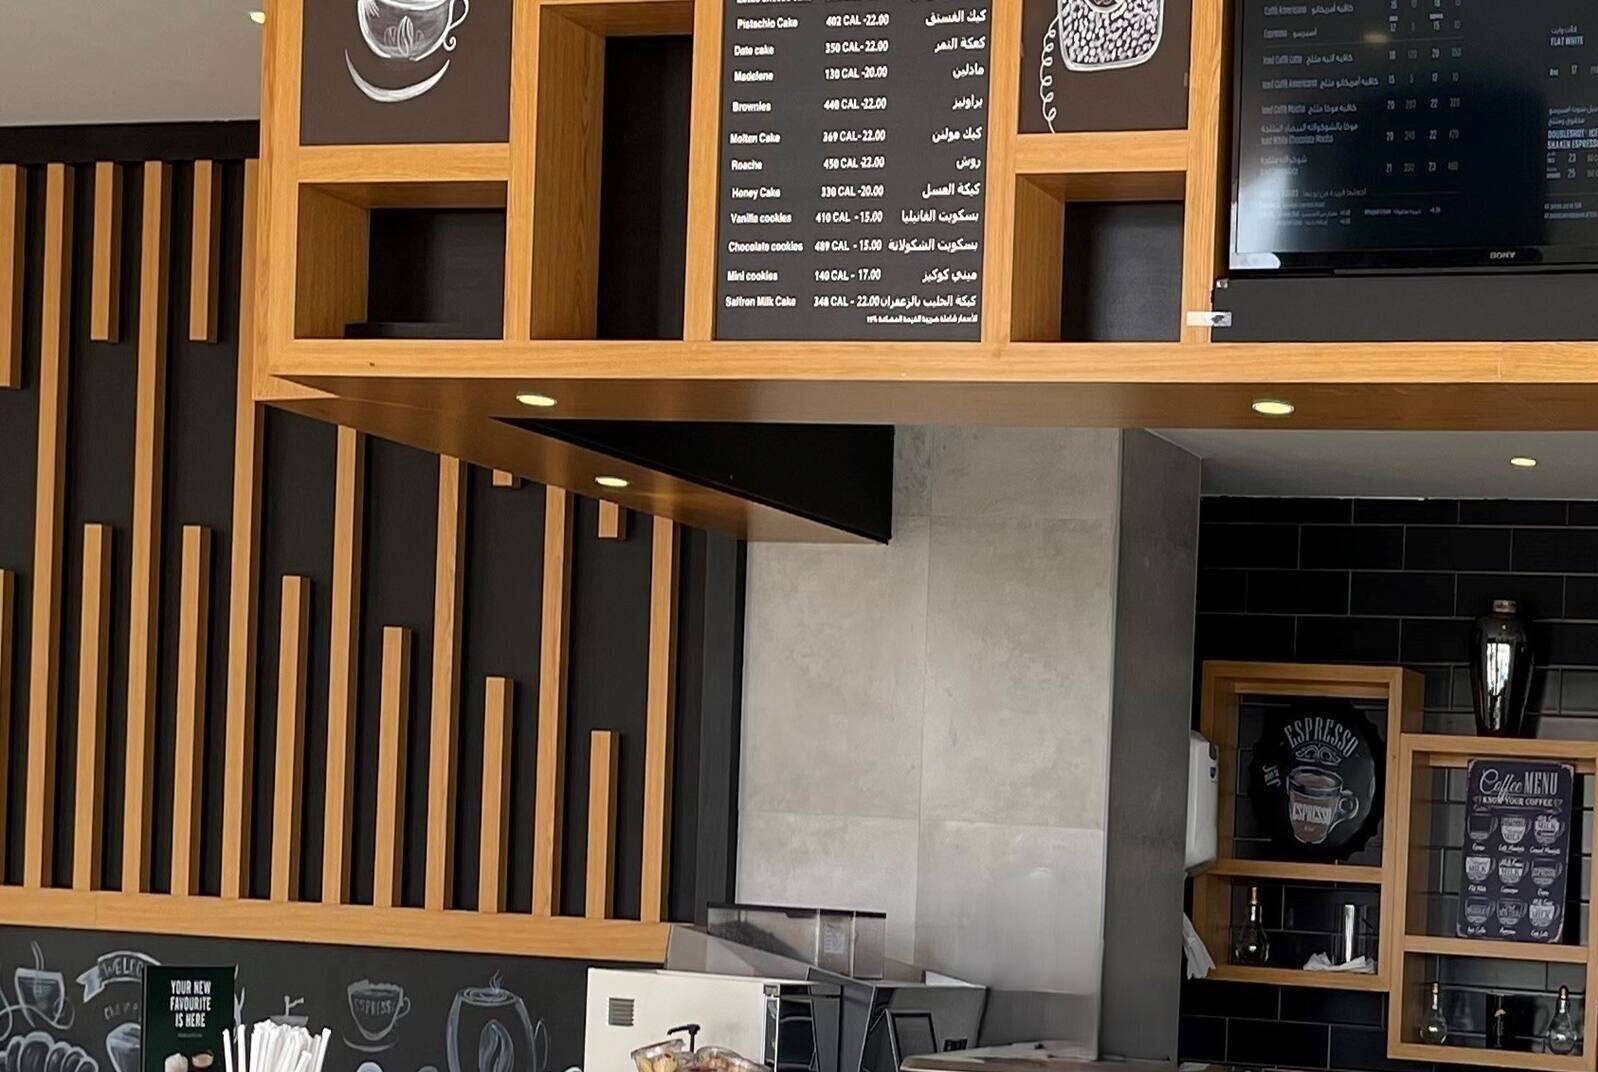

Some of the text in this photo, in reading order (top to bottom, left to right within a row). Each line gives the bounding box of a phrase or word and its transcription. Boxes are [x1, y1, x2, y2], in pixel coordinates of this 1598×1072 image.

[777, 17, 798, 28] Cake
[843, 15, 861, 25] CAL
[734, 45, 774, 56] Date cake
[842, 68, 860, 78] CAL
[841, 99, 859, 109] CAL
[759, 133, 780, 143] Cake
[841, 158, 858, 168] CAL
[732, 187, 780, 200] Honey Cake
[838, 186, 856, 196] CAL
[760, 213, 792, 223] cookies
[833, 212, 851, 222] CAL
[728, 241, 803, 252] Chocolate cookies
[831, 241, 849, 251] CAL
[746, 270, 778, 281] cookies
[831, 269, 881, 280] CAL 17.00
[775, 296, 796, 306] Cake
[830, 296, 848, 306] CAL
[1284, 717, 1359, 758] ESPRESSO
[1480, 768, 1558, 799] Coffee MENU
[171, 980, 212, 994] YOUR NEW
[170, 998, 212, 1010] FAVOURITE
[175, 1014, 206, 1027] IS HERE
